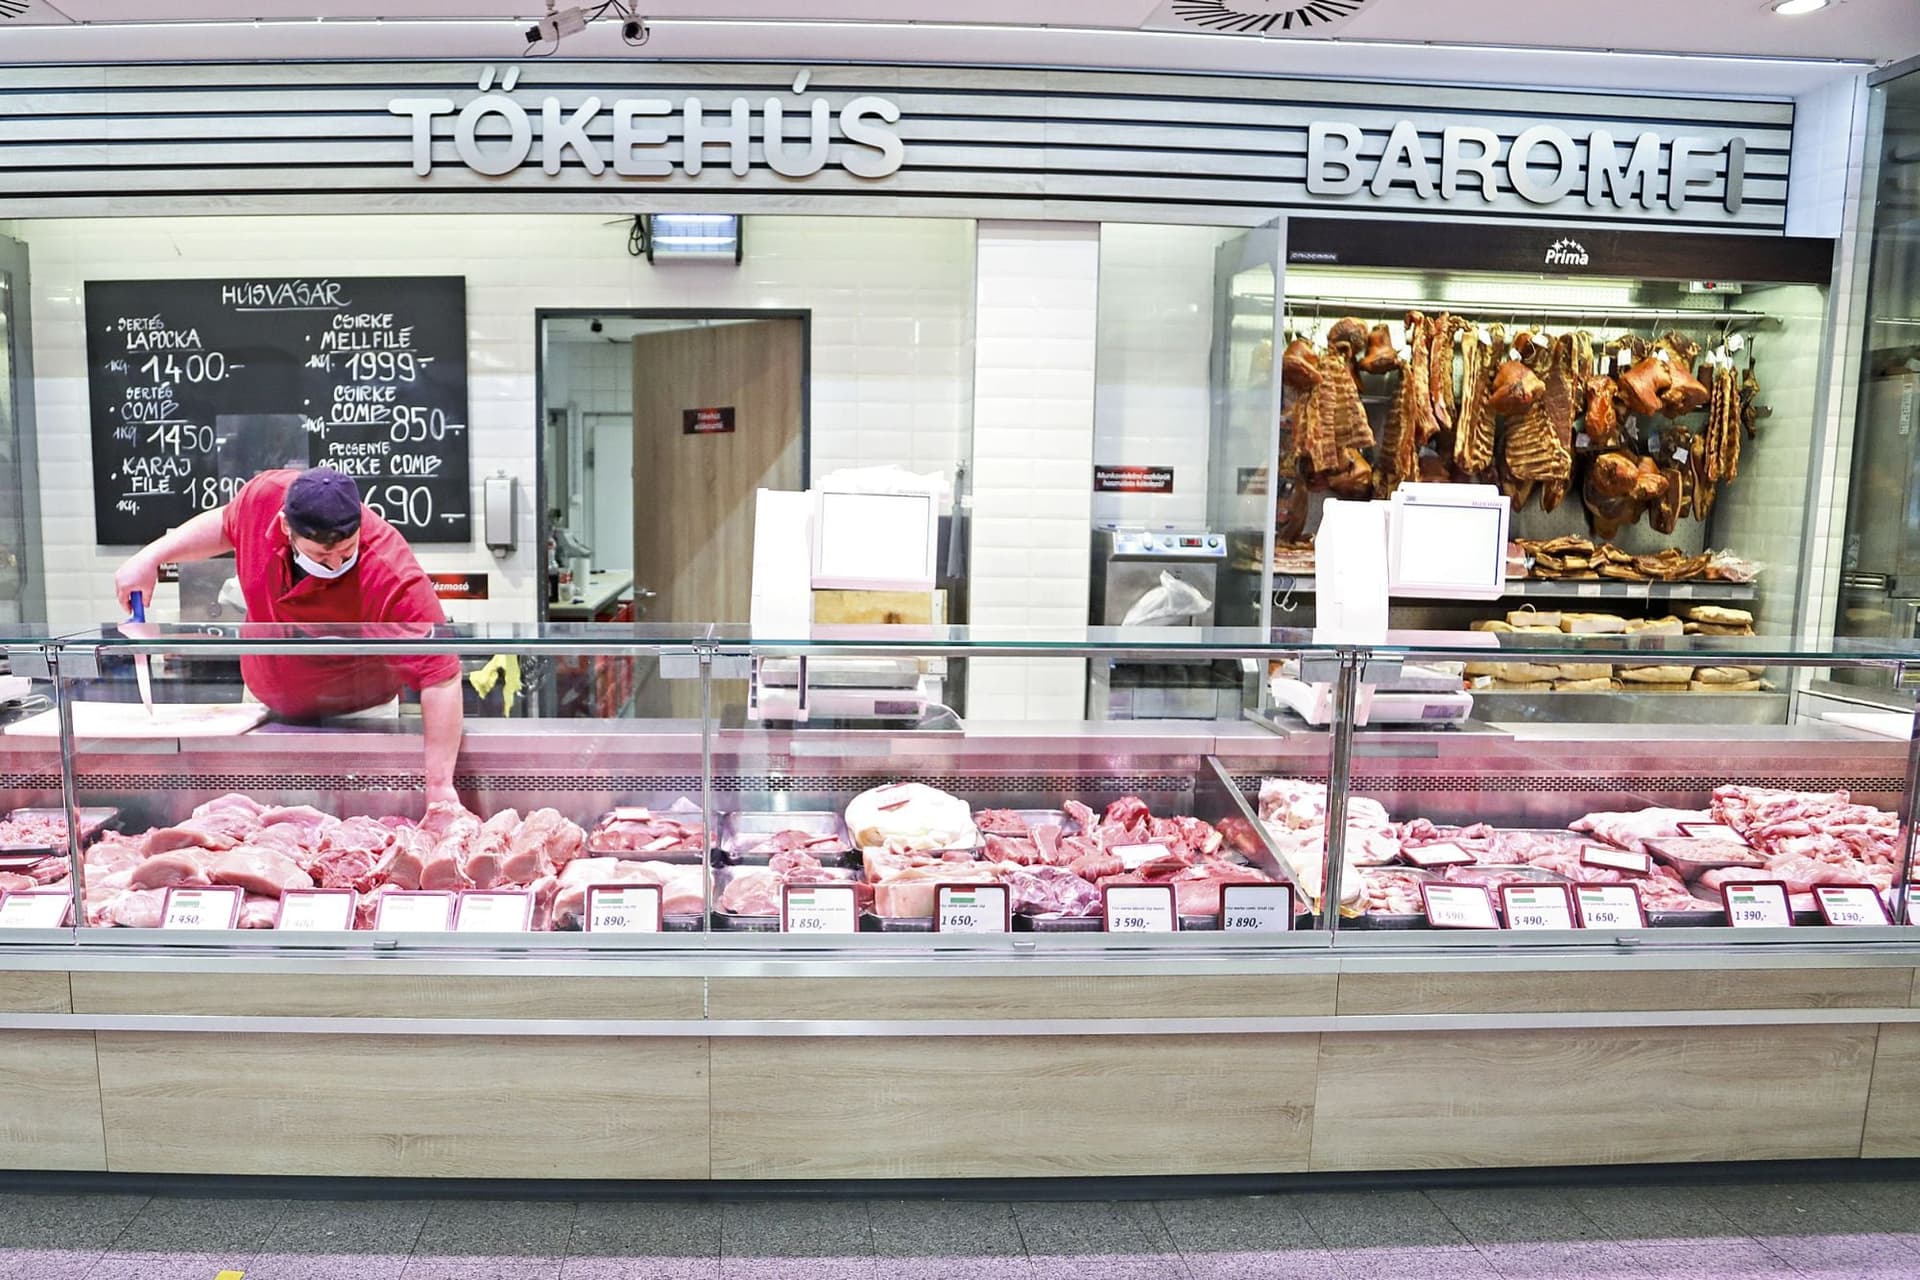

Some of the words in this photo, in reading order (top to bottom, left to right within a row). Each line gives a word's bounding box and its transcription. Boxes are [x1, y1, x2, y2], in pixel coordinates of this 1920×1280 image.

[388, 66, 904, 178] TŐKEHÚS
[1306, 120, 1746, 214] BAROMFI
[222, 279, 352, 306] HÚSVÁSÁR
[118, 313, 165, 331] SERTÉS
[332, 313, 394, 329] CSIRKE
[126, 328, 202, 351] LAPOCKA
[320, 326, 415, 351] MELLFILÉ
[126, 381, 173, 400] SERTÉS
[333, 385, 397, 402] CSIRKE
[121, 400, 180, 421] COMB
[331, 403, 391, 423] COMB
[329, 441, 391, 455] PECSENYE
[122, 456, 191, 477] KARAJ
[390, 454, 442, 474] COMB
[131, 475, 170, 494] FILÉ
